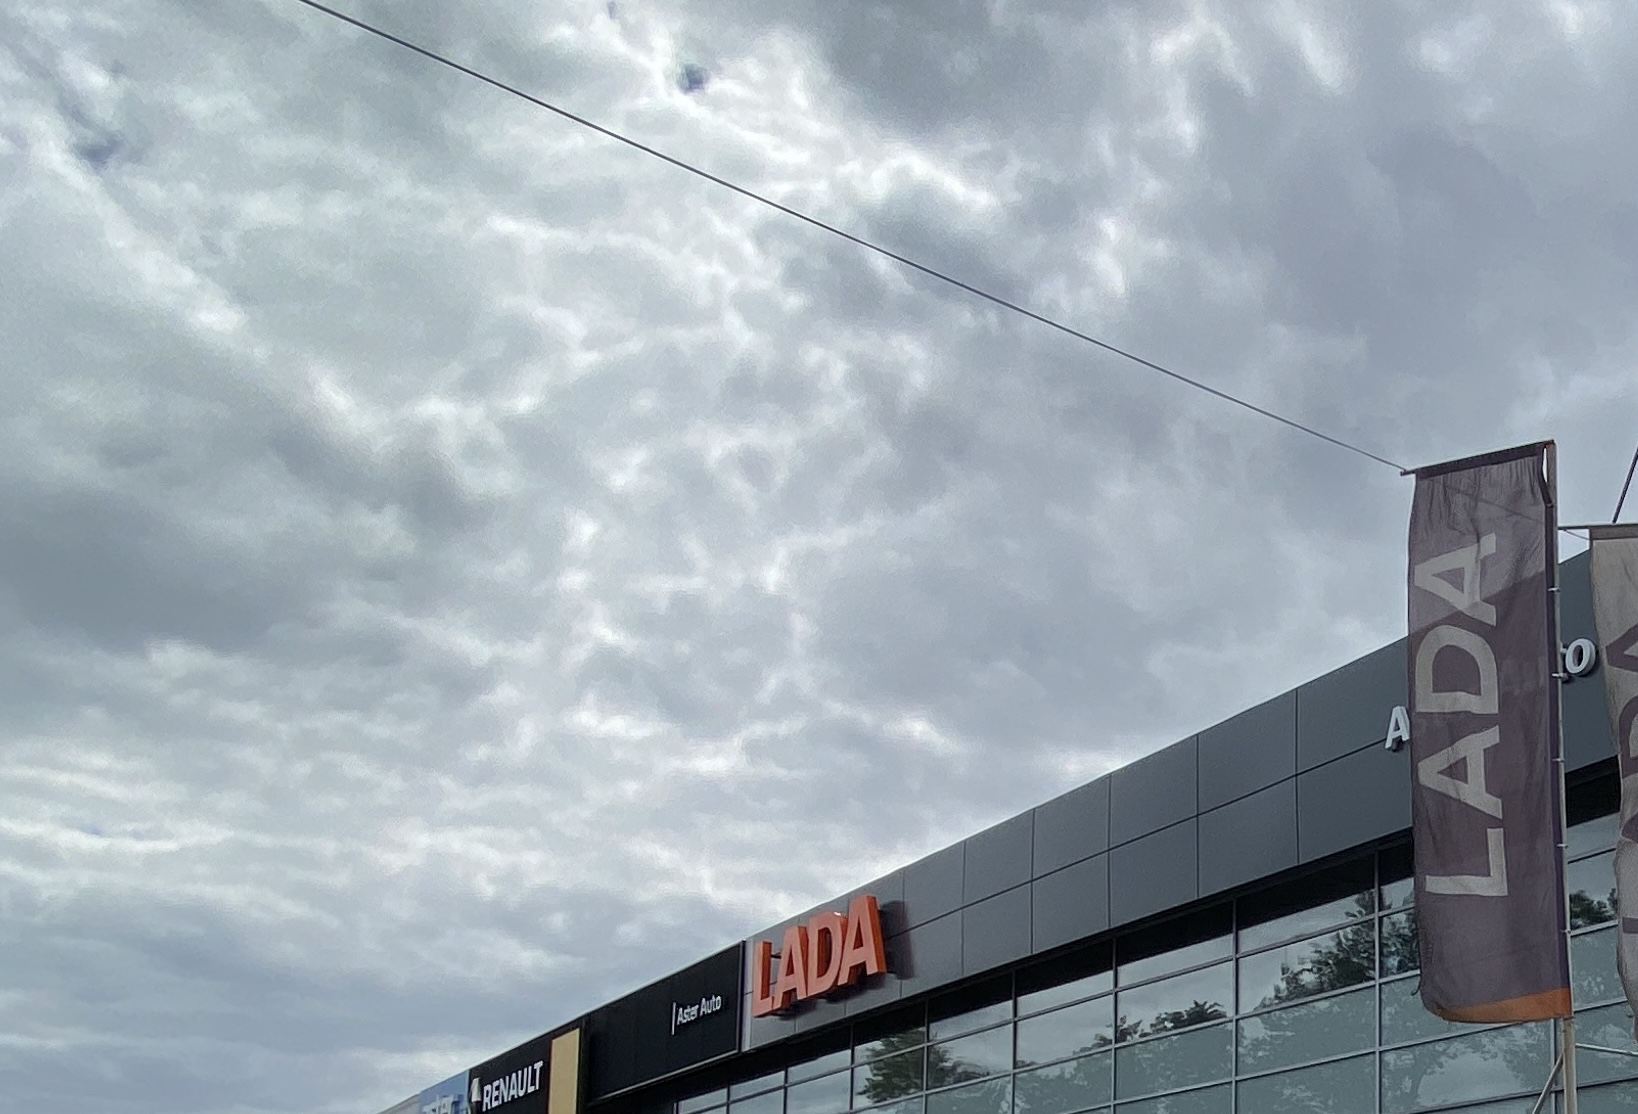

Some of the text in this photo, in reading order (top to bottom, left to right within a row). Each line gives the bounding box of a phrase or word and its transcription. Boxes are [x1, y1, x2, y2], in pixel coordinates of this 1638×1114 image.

[1414, 532, 1508, 898] LADA
[753, 895, 887, 1018] LADA
[677, 994, 722, 1026] Aster Auto
[482, 1060, 543, 1112] RENAULT
